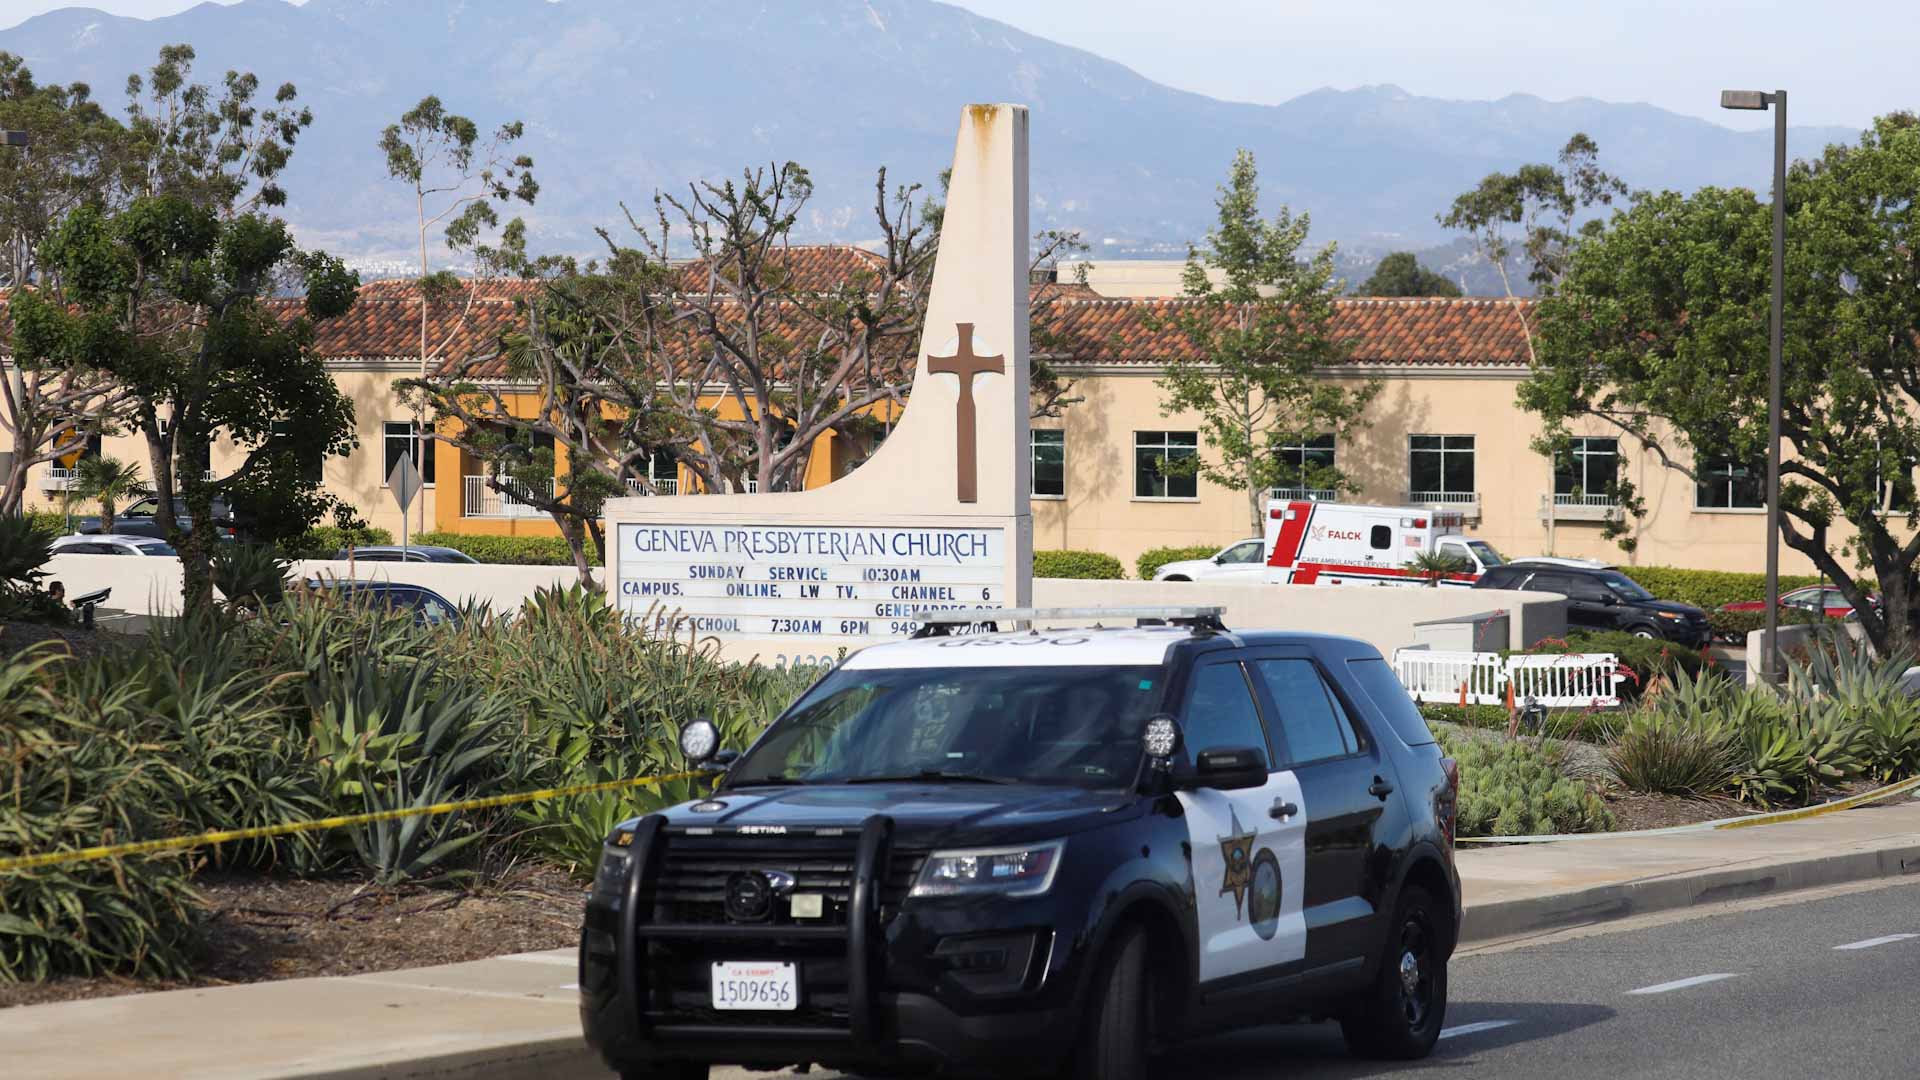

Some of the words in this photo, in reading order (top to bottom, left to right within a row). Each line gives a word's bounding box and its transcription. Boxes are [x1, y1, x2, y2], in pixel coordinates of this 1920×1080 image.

[1328, 530, 1361, 541] FALCK
[635, 529, 717, 552] GENEVA
[724, 531, 886, 562] PRESBYTERIAN
[892, 533, 987, 564] CHURCH
[1321, 558, 1360, 566] AMBULANCE
[689, 565, 744, 579] SUNDAY
[769, 566, 828, 581] SERVICE
[862, 568, 921, 582] 10:30AM
[800, 585, 820, 598] LW
[891, 586, 955, 600] CHANNEL
[982, 587, 990, 600] 6
[771, 619, 822, 633] 7:30AM
[840, 620, 869, 634] 6PM
[741, 825, 787, 834] SETINA
[719, 980, 790, 1002] 1509656
